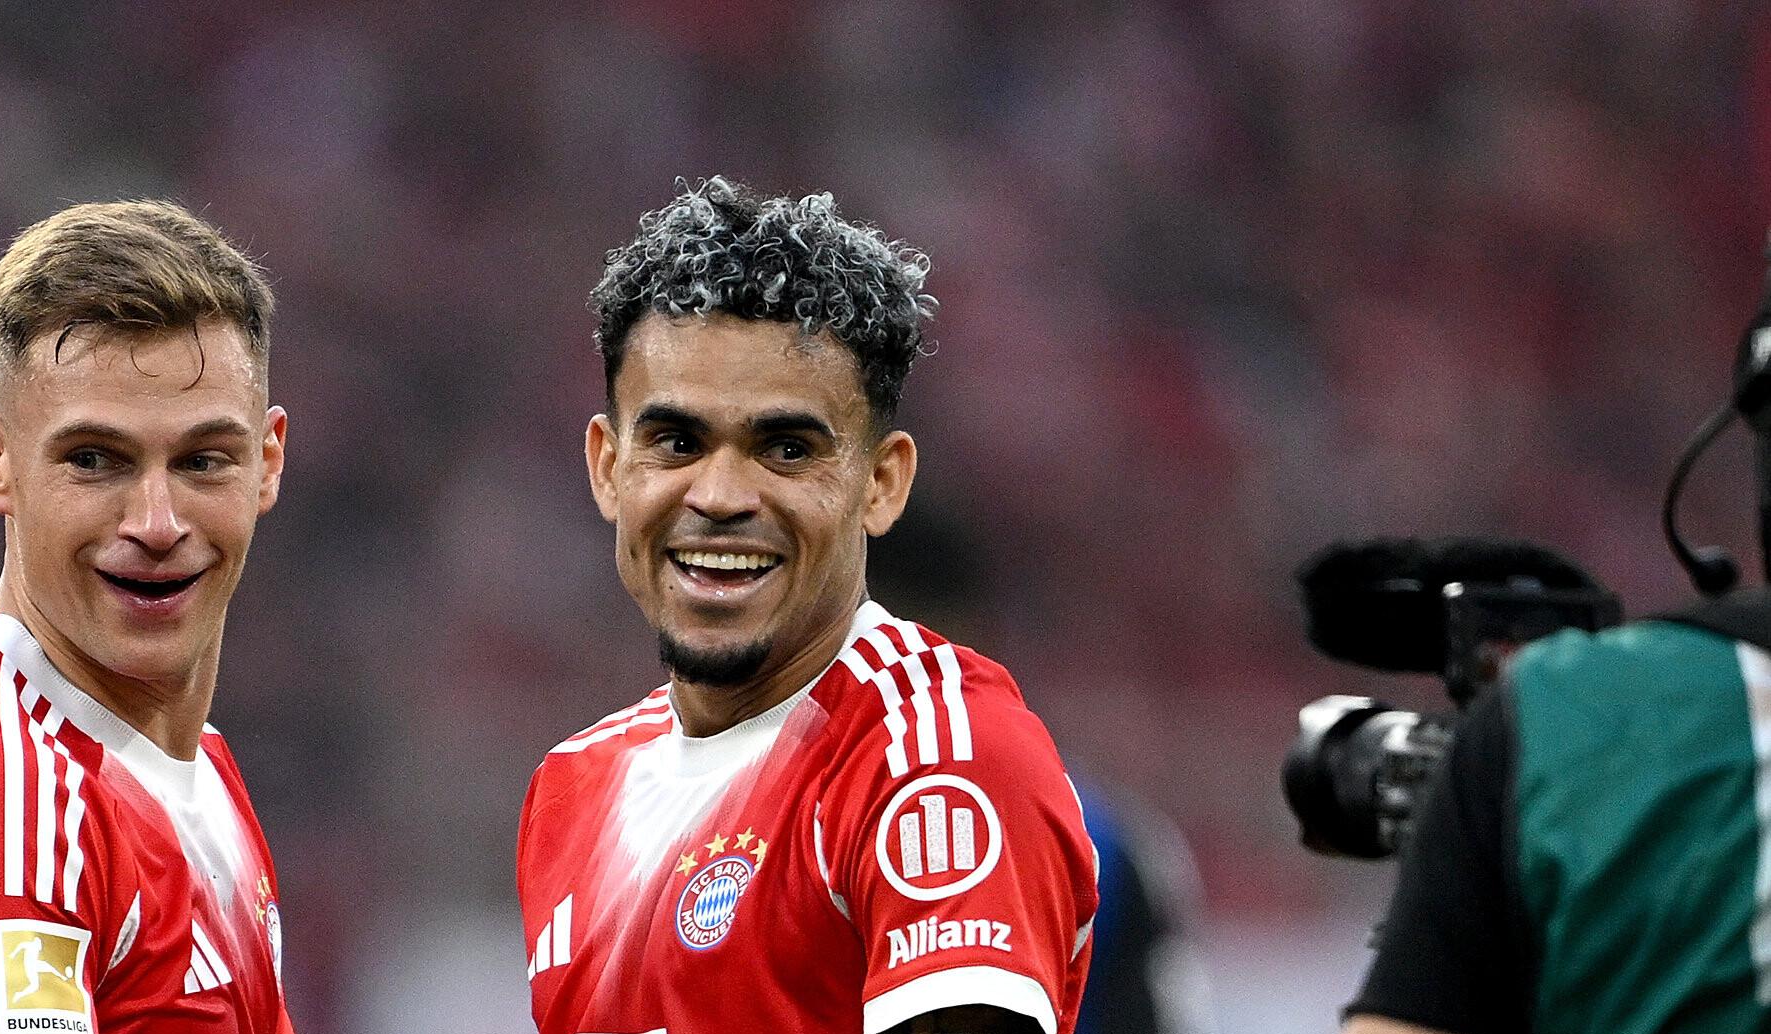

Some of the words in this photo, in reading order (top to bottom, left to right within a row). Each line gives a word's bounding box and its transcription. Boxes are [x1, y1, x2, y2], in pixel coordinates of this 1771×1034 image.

[690, 874, 712, 895] FC
[886, 915, 1013, 969] Allianz
[8, 1017, 88, 1033] BUNDESLIGA
